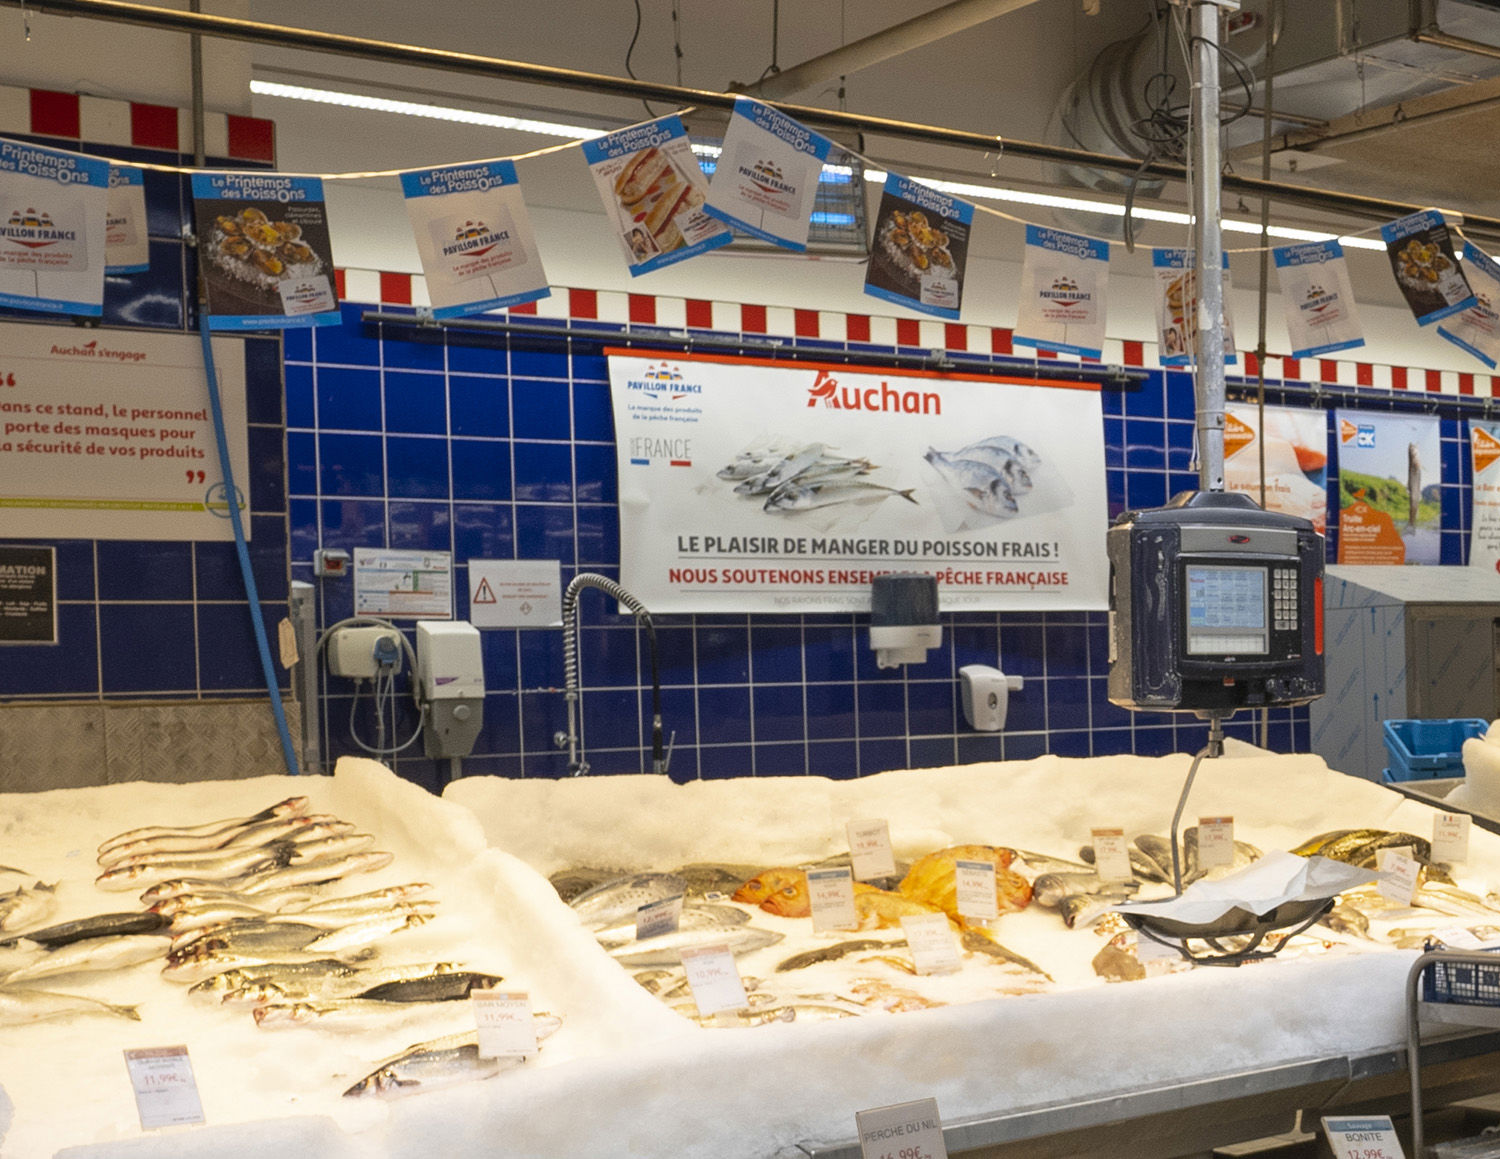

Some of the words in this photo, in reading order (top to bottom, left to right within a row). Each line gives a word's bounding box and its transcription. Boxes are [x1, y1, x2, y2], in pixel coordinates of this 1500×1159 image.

[763, 108, 810, 140] Printemps
[608, 123, 659, 146] Printemps
[2, 143, 76, 169] Printemps
[211, 177, 224, 187] Le
[226, 175, 292, 189] Printemps
[420, 177, 432, 185] Le
[431, 166, 489, 182] Printemps
[738, 166, 770, 185] PAVILLON
[770, 178, 796, 194] FRANCE
[221, 189, 241, 198] des
[429, 185, 447, 195] des
[908, 181, 953, 207] Printemps
[37, 229, 76, 241] FRANCE
[442, 239, 479, 256] PAVILLON
[479, 230, 510, 246] FRANCE
[1047, 230, 1089, 248] Printemps
[50, 344, 96, 357] Auchan
[97, 348, 147, 361] s'engage
[627, 381, 667, 392] PAVILLON
[669, 382, 702, 394] FRANCE
[807, 370, 941, 416] Auchan
[0, 402, 32, 415] ans
[35, 403, 53, 415] ce
[56, 402, 109, 420] stand,
[112, 404, 126, 417] le
[130, 408, 208, 422] personnel
[4, 422, 50, 436] porte
[53, 422, 81, 435] des
[85, 425, 156, 440] masques
[160, 428, 196, 442] pour
[16, 439, 83, 455] sécurité
[86, 442, 105, 455] de
[108, 445, 136, 456] vos
[139, 444, 205, 460] produits
[636, 437, 691, 460] FRANCE
[678, 536, 700, 553] LE
[704, 536, 779, 555] PLAISIR
[784, 537, 807, 554] DE
[811, 538, 890, 556] MANGER
[894, 540, 918, 556] DU
[922, 540, 998, 557] POISSON
[1002, 541, 1050, 557] FRAIS
[669, 568, 718, 585] NOUS
[722, 569, 825, 586] SOUTENONS
[936, 567, 983, 586] PÊCHE
[986, 571, 1069, 591] FRANÇAISE
[863, 1126, 905, 1143] PERCHE
[905, 1123, 921, 1135] DU
[921, 1119, 938, 1130] NIL
[1345, 1132, 1384, 1142] BONITE
[880, 1146, 922, 1159] 699€
